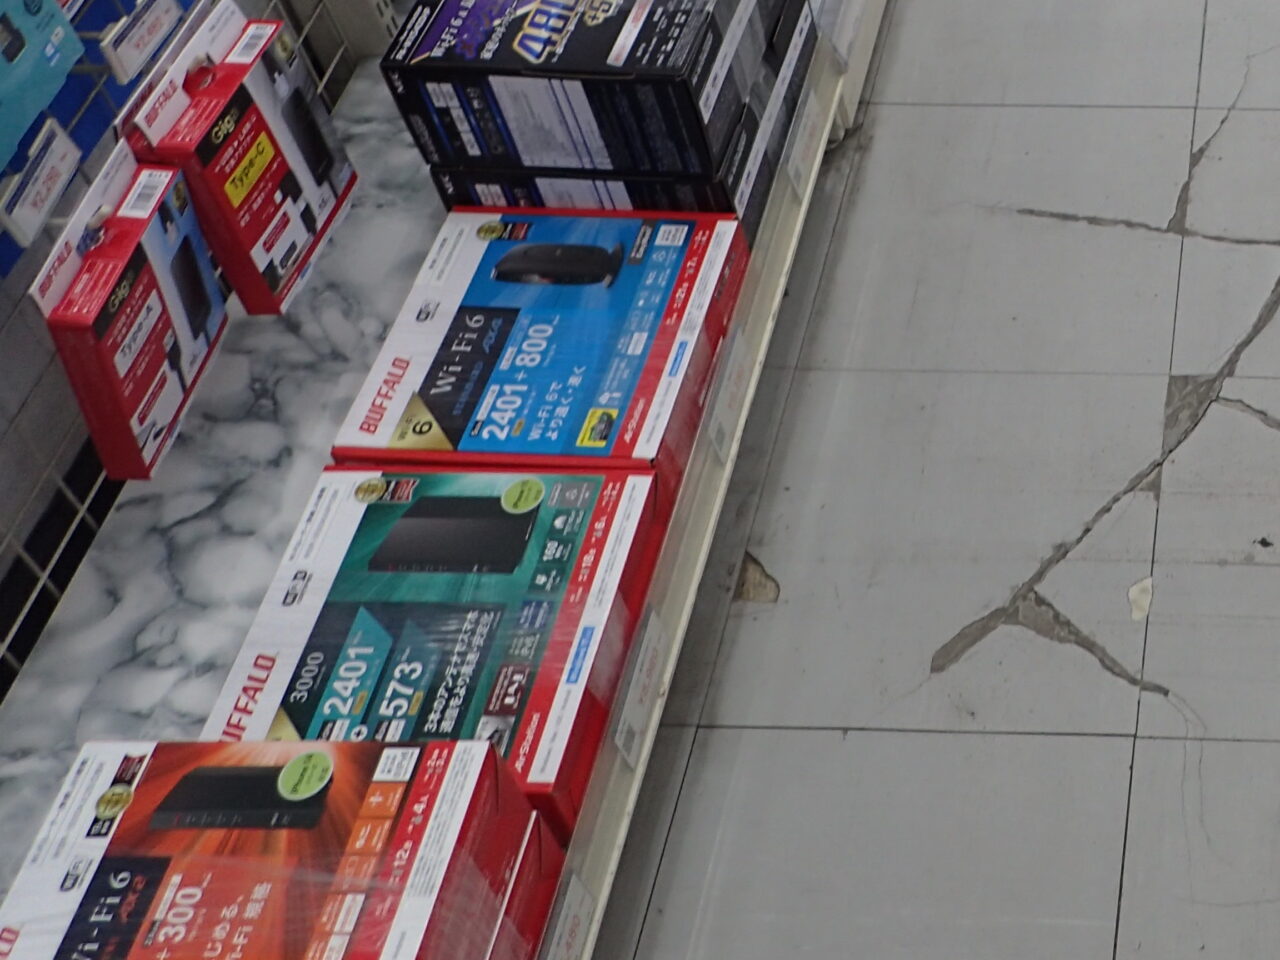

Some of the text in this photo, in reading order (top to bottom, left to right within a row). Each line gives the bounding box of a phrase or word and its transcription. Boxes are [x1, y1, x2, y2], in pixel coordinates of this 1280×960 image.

[230, 140, 266, 190] Type-C
[120, 304, 154, 359] Type-A
[429, 313, 486, 396] Wi-Fi 6
[358, 356, 411, 436] BUFFALO
[482, 383, 528, 441] 2401
[515, 323, 554, 369] 800
[411, 419, 434, 436] 6
[220, 653, 278, 742] UFFALO
[290, 651, 325, 704] 3000
[323, 646, 374, 716] 2401
[379, 661, 424, 718] 573
[514, 711, 541, 775] AirStation
[70, 869, 132, 960] i-Fi 6
[157, 886, 203, 945] 300
